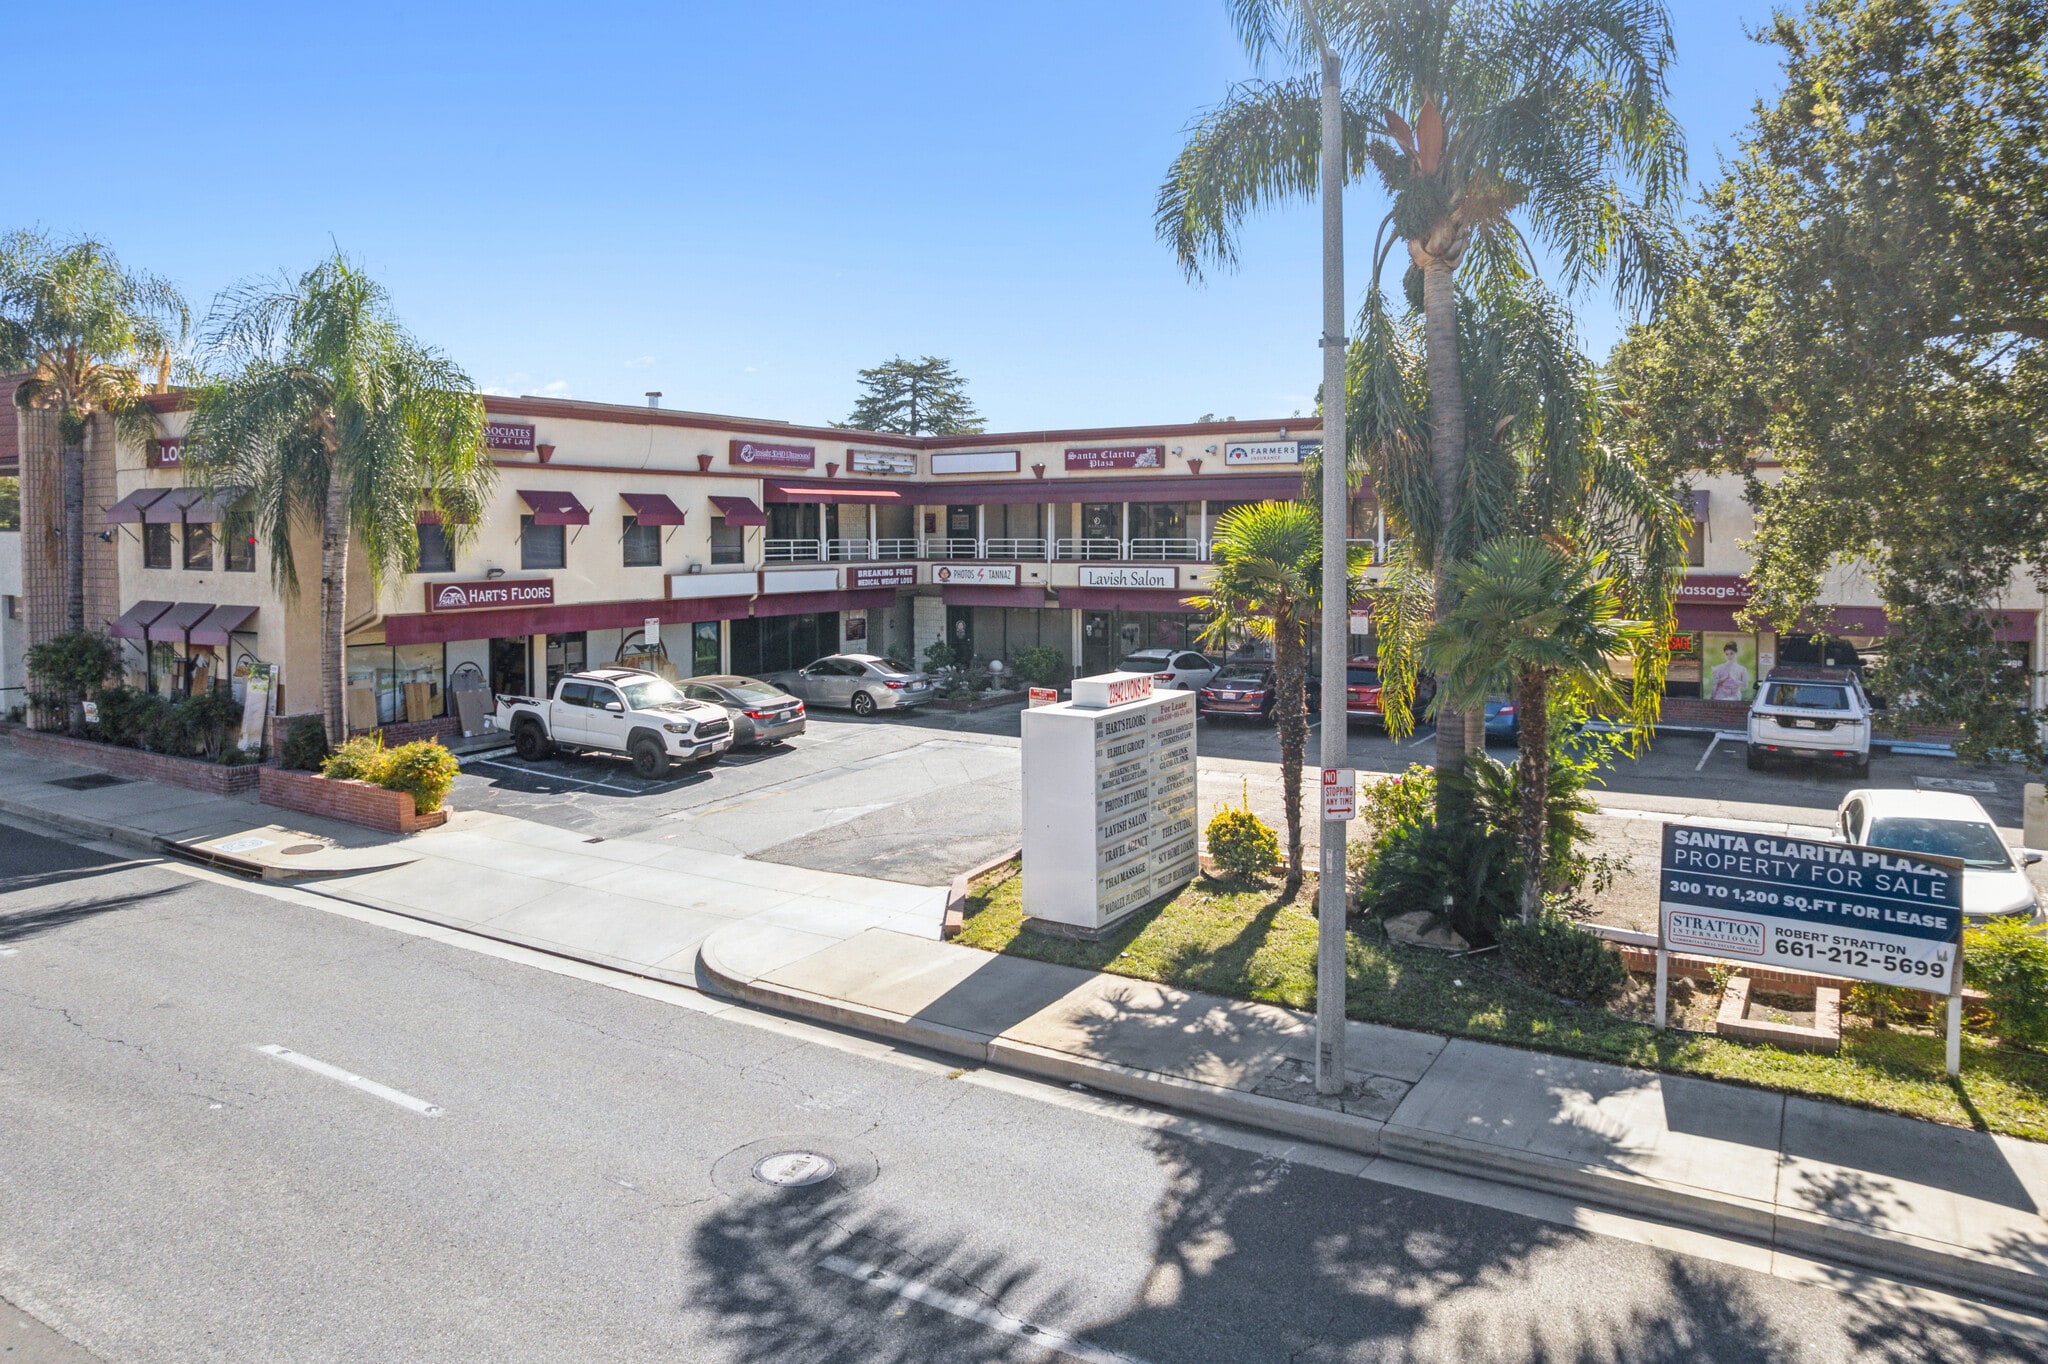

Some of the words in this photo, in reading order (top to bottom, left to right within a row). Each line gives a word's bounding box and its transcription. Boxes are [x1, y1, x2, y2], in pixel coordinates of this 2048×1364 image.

[1067, 451, 1097, 460] Santa
[1101, 450, 1136, 459] Clarita
[1250, 446, 1295, 455] FARMERS
[857, 568, 894, 578] BREAKING
[896, 568, 913, 577] FREE
[953, 569, 975, 580] PHOTOS
[988, 569, 1012, 580] TANNAZ
[1089, 569, 1128, 586] Lavish
[1131, 569, 1165, 586] Salon
[857, 578, 880, 587] MEDICAL
[881, 577, 899, 586] WEIGHT
[900, 577, 913, 585] LOSS
[469, 589, 508, 603] HART'S
[511, 587, 551, 601] FLOORS
[1671, 585, 1735, 598] Massage
[1124, 679, 1141, 701] LYONS
[1142, 676, 1152, 696] AVE
[1160, 705, 1170, 714] For
[1171, 701, 1187, 711] Lease
[1105, 719, 1125, 735] HART'S
[1125, 715, 1146, 730] FLOORS
[1126, 739, 1146, 752] GROUP
[1325, 771, 1336, 784] NO
[1326, 786, 1353, 797] STOPPING
[1326, 798, 1338, 806] ANY
[1339, 797, 1353, 805] TIME
[1105, 817, 1127, 838] LAVISH
[1128, 811, 1147, 830] SALON
[1162, 825, 1173, 838] THE
[1174, 816, 1193, 833] STUDIO
[1105, 845, 1126, 863] TRAVEL
[1127, 835, 1148, 853] AGENCY
[1674, 829, 1749, 853] SANTA
[1754, 839, 1857, 866] CLARITA
[1105, 875, 1120, 890] THAI
[1120, 862, 1146, 883] MASSAGE
[1675, 848, 1800, 879] PROPERTY
[1811, 865, 1863, 888] FOR
[1874, 874, 1946, 900] SALE
[1669, 880, 1701, 895] 300
[1705, 884, 1728, 898] TO
[1732, 888, 1779, 904] 1,200
[1783, 894, 1837, 913] SQ.FT
[1841, 902, 1880, 920] FOR
[1884, 909, 1948, 930] LEASE
[1673, 914, 1760, 938] STRATTON
[1673, 927, 1760, 945] INTERNATIONAL
[1775, 927, 1829, 943] ROBERT
[1832, 936, 1907, 955] STRATTON
[1775, 939, 1945, 979] 661-212-5699
